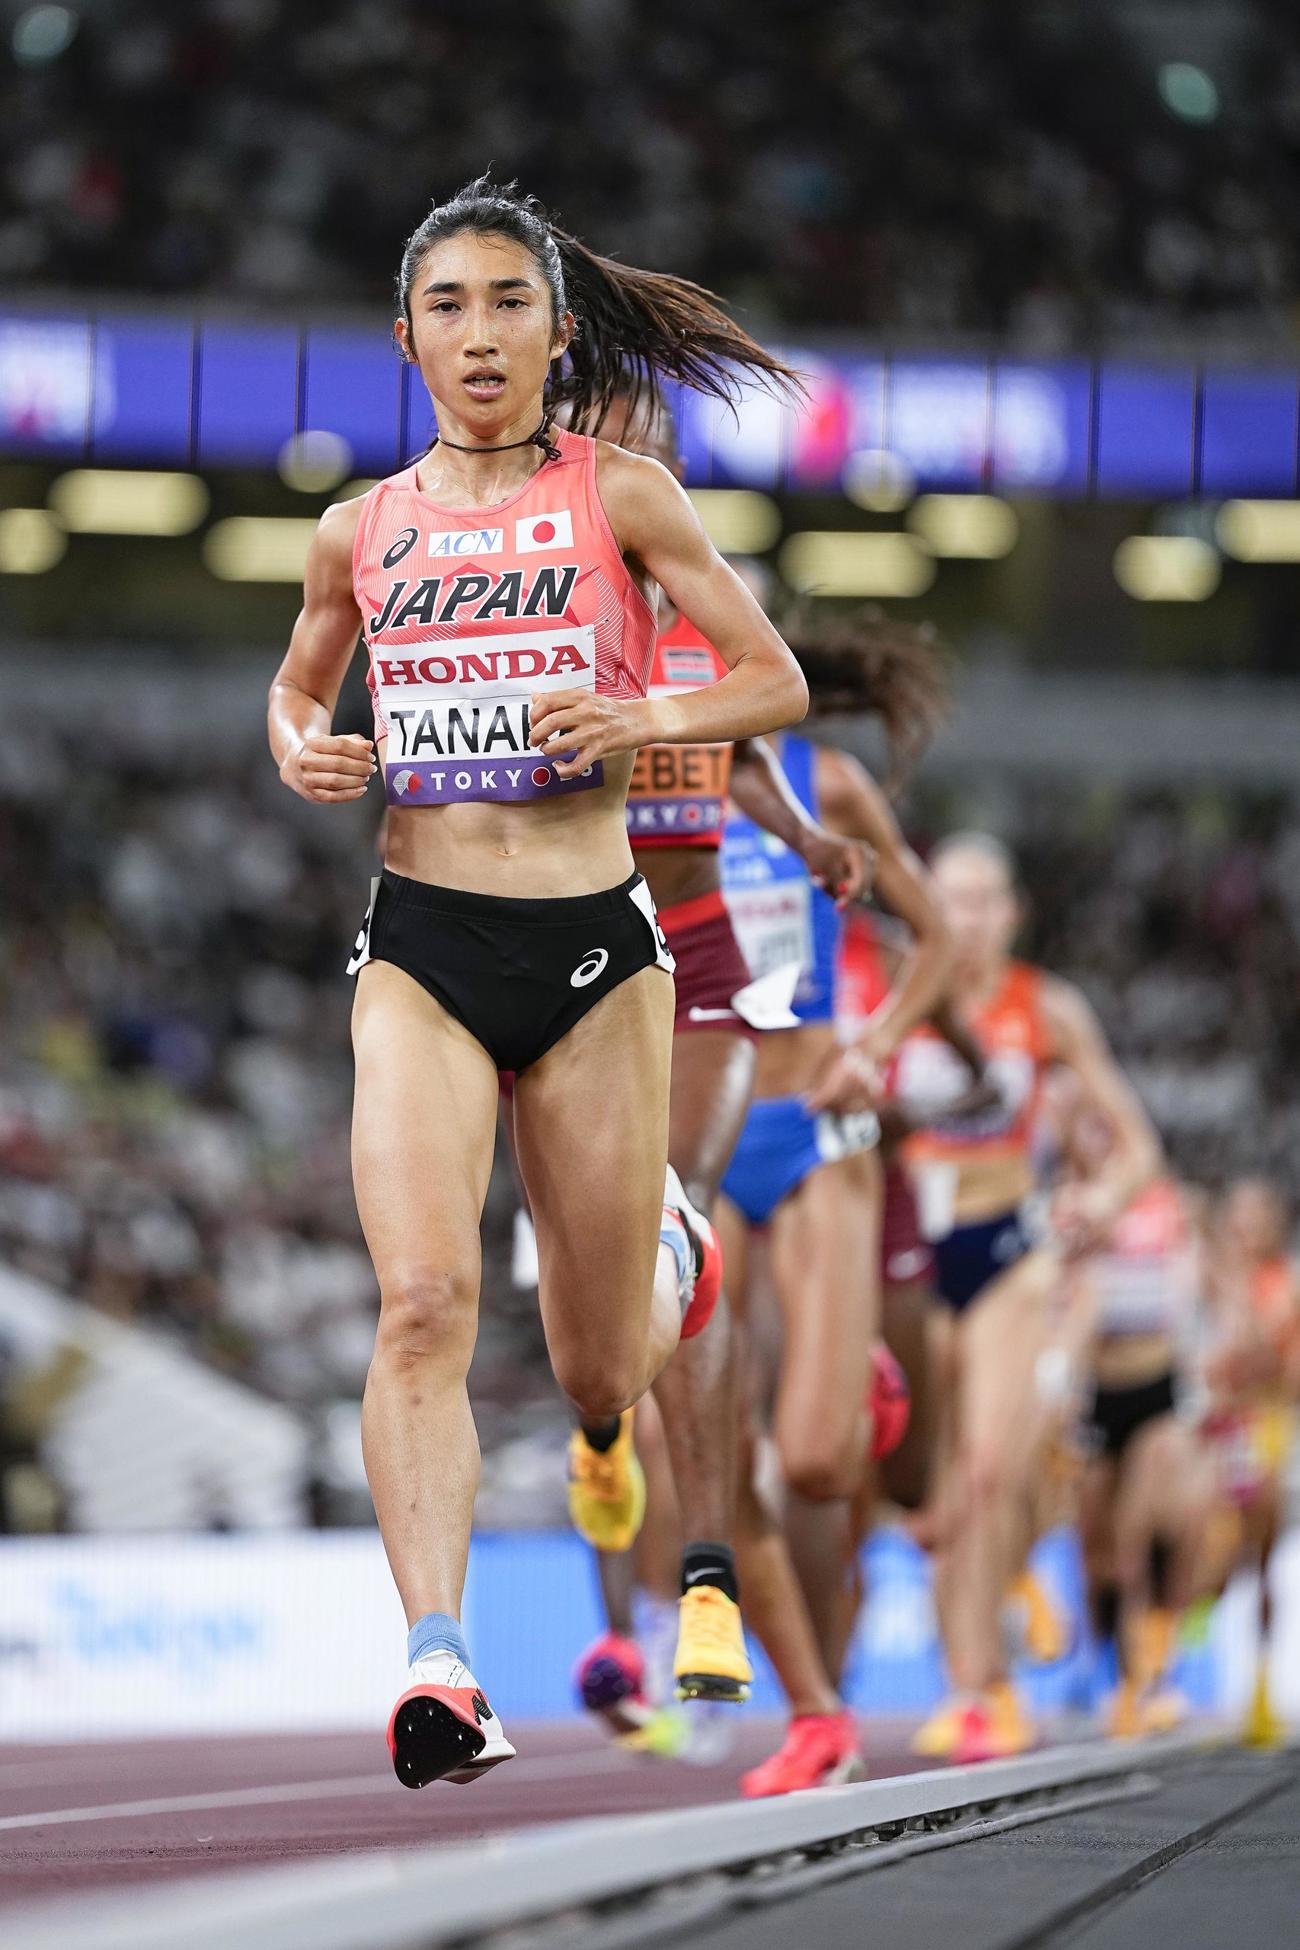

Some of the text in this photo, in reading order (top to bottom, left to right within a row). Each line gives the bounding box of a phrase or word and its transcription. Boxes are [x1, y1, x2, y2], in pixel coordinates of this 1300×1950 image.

[434, 530, 502, 555] ACN
[370, 566, 580, 633] JAPAN
[377, 645, 590, 686] HONDA
[390, 703, 577, 757] TANA
[431, 765, 593, 791] TOKYO
